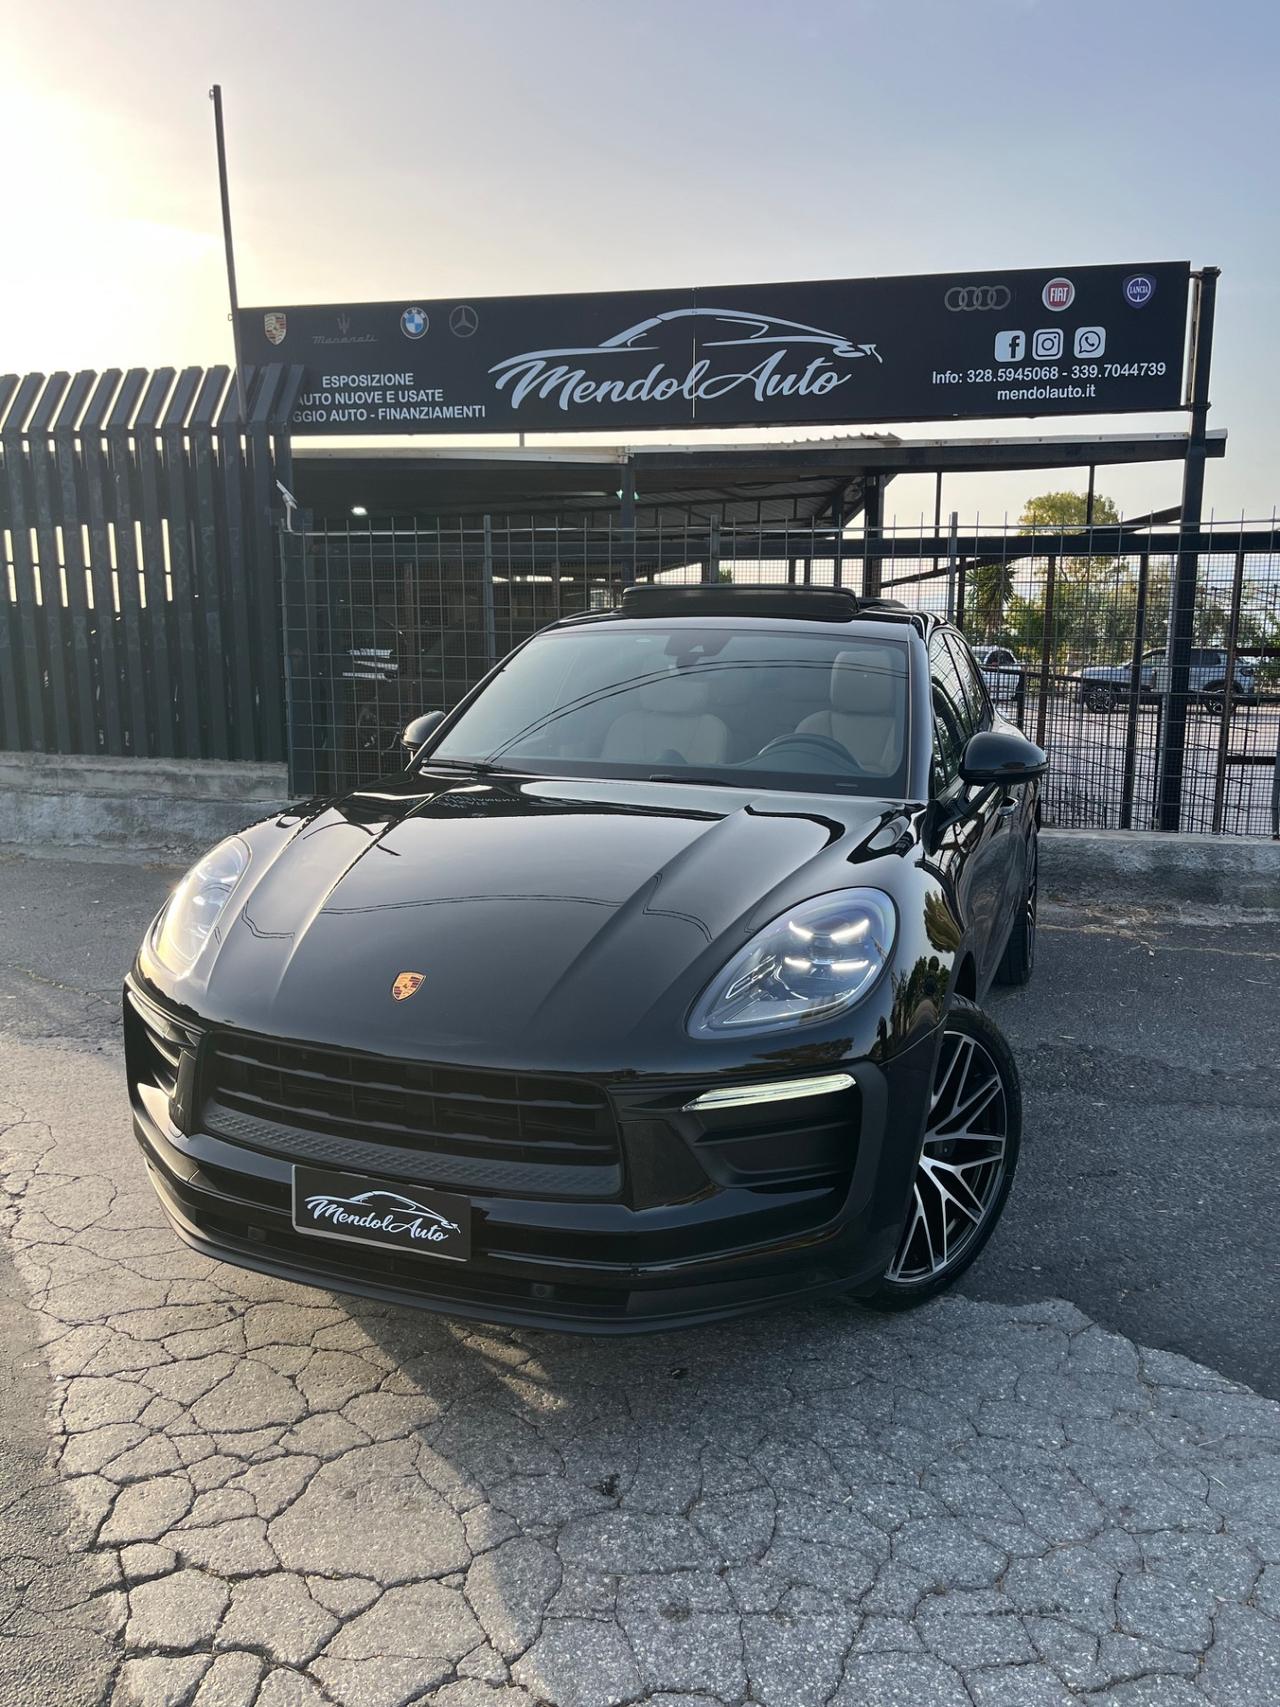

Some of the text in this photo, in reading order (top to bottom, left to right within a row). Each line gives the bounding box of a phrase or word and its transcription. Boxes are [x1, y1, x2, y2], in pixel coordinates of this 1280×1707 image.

[1050, 287, 1069, 302] FIAT
[1129, 285, 1149, 294] LANCIA
[322, 373, 415, 388] ESPOSIZIONE
[932, 370, 963, 384] Info:
[966, 366, 1059, 383] 328.5945068
[1071, 362, 1167, 379] 339.7044739
[335, 391, 383, 405] NUOVE
[386, 391, 395, 404] E
[398, 389, 444, 403] USATE
[996, 384, 1096, 401] mendolauto.it
[292, 410, 327, 423] GGIO
[329, 409, 368, 422] AUTO
[378, 405, 486, 420] FINANZIAMENTI
